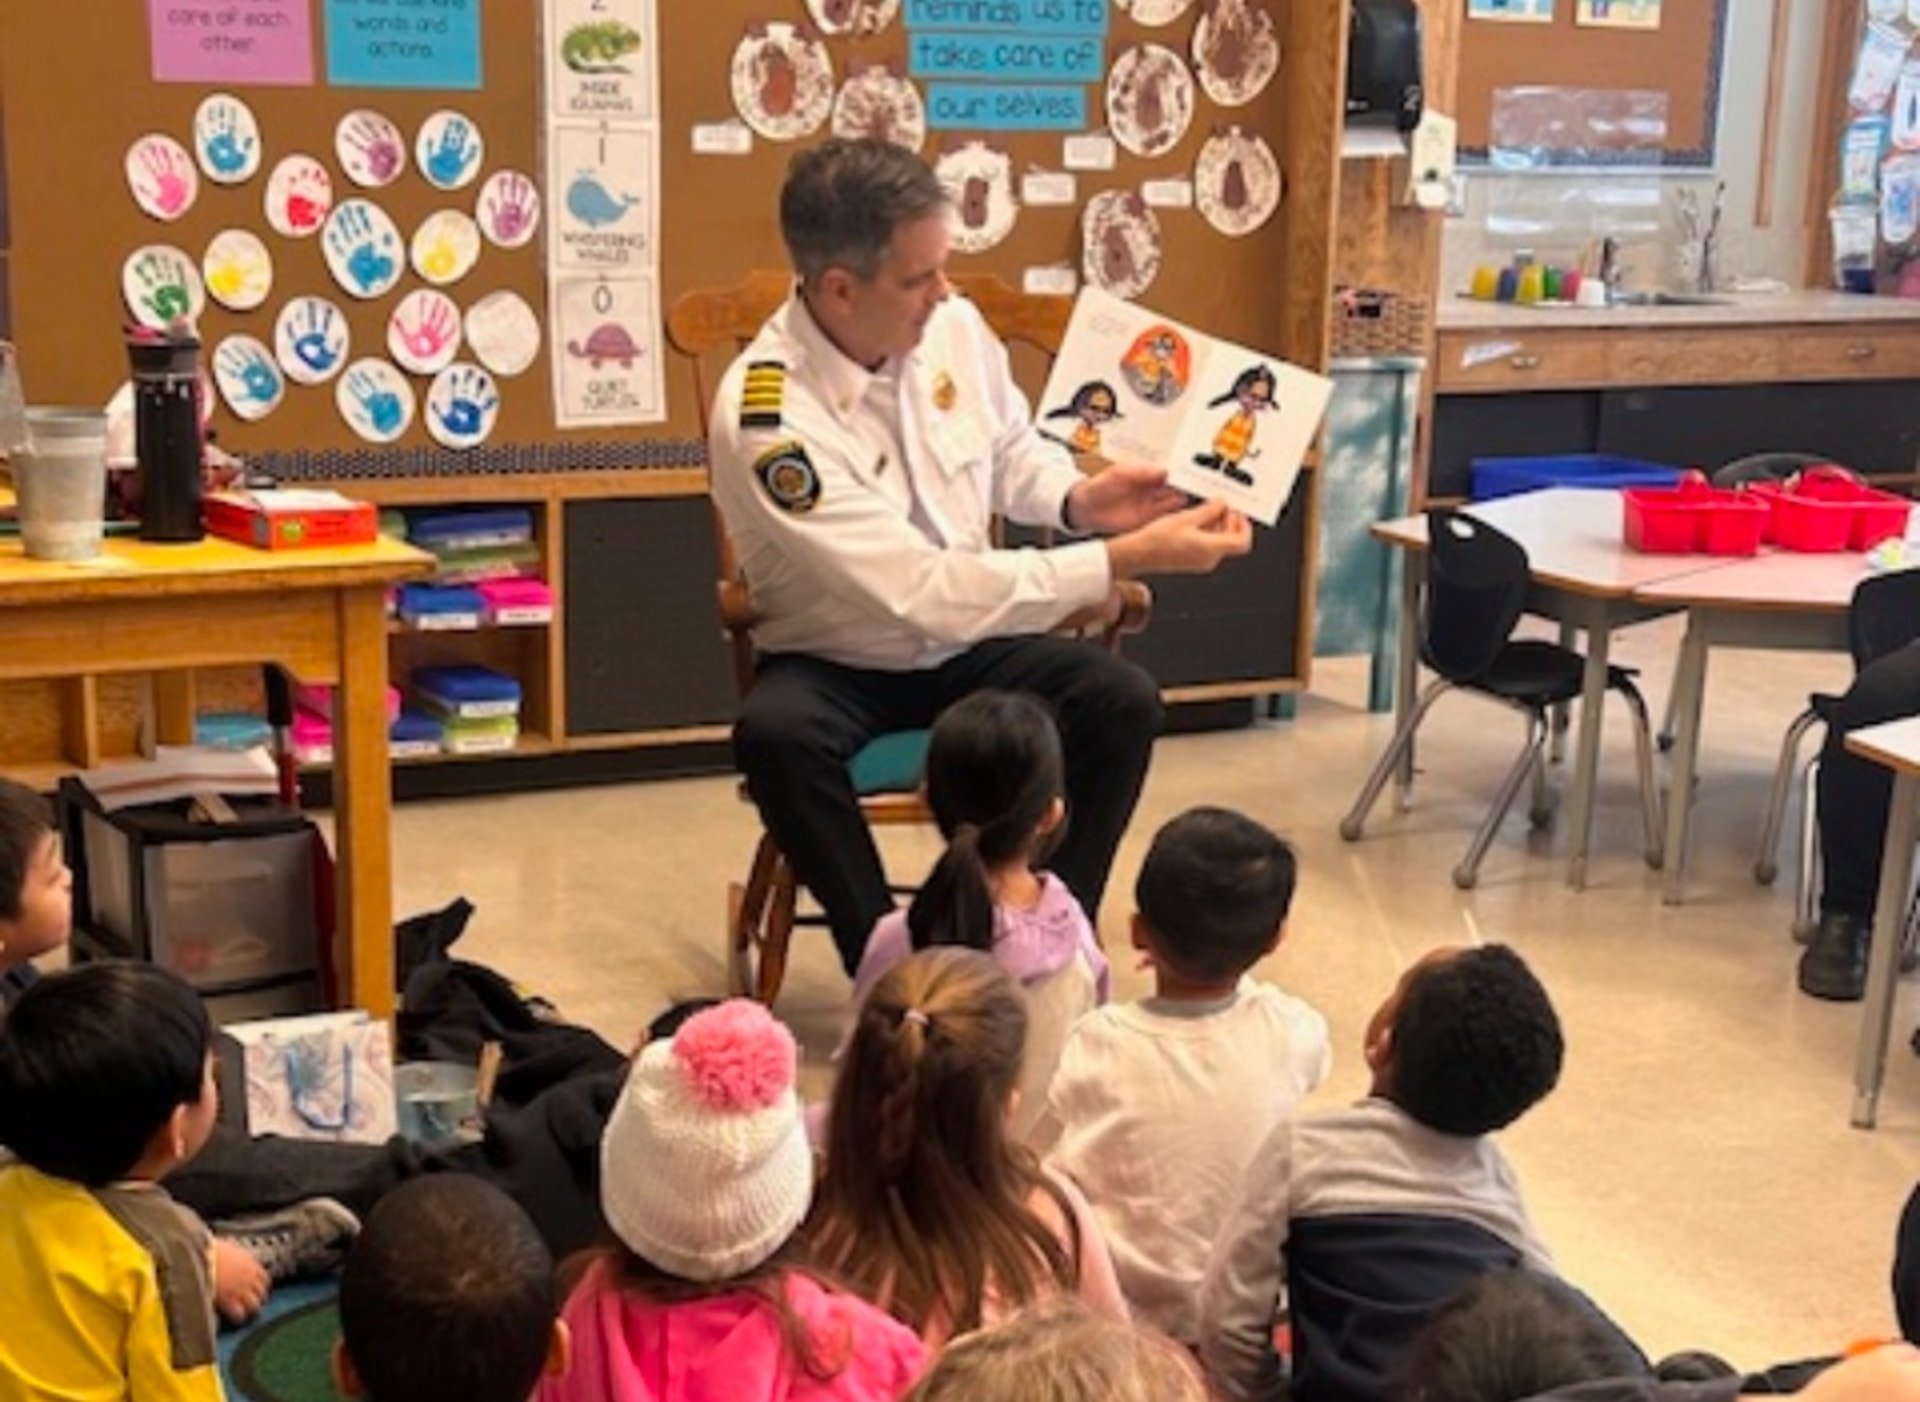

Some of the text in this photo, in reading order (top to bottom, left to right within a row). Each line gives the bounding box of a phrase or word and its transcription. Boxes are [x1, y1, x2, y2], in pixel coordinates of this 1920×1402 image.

[1032, 0, 1064, 22] us
[1072, 0, 1104, 22] to
[919, 38, 1098, 70] take care of
[935, 96, 986, 119] our
